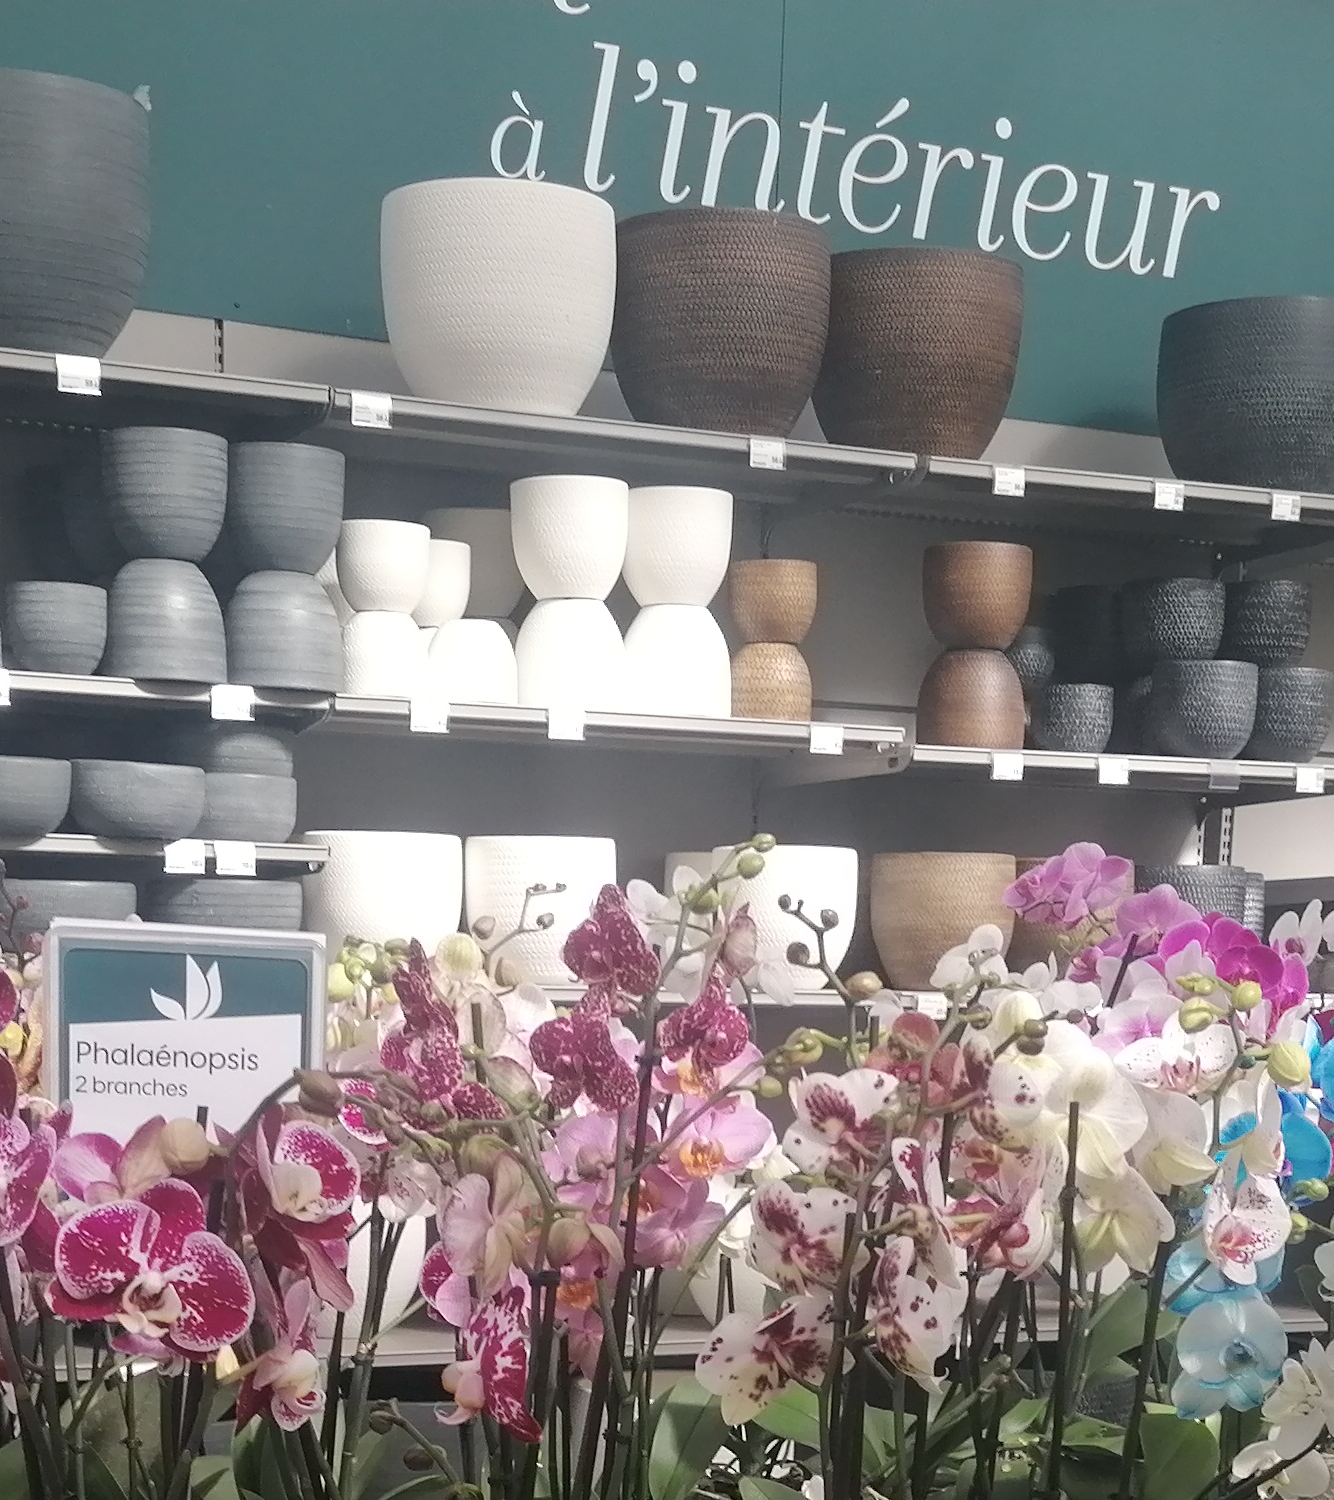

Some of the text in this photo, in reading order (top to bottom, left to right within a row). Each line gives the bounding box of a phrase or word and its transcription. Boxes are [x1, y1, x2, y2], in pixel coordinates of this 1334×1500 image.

[489, 42, 1221, 279] à l'intérieur
[75, 1040, 260, 1076] Phalaénopsis
[75, 1074, 189, 1098] 2 branches
